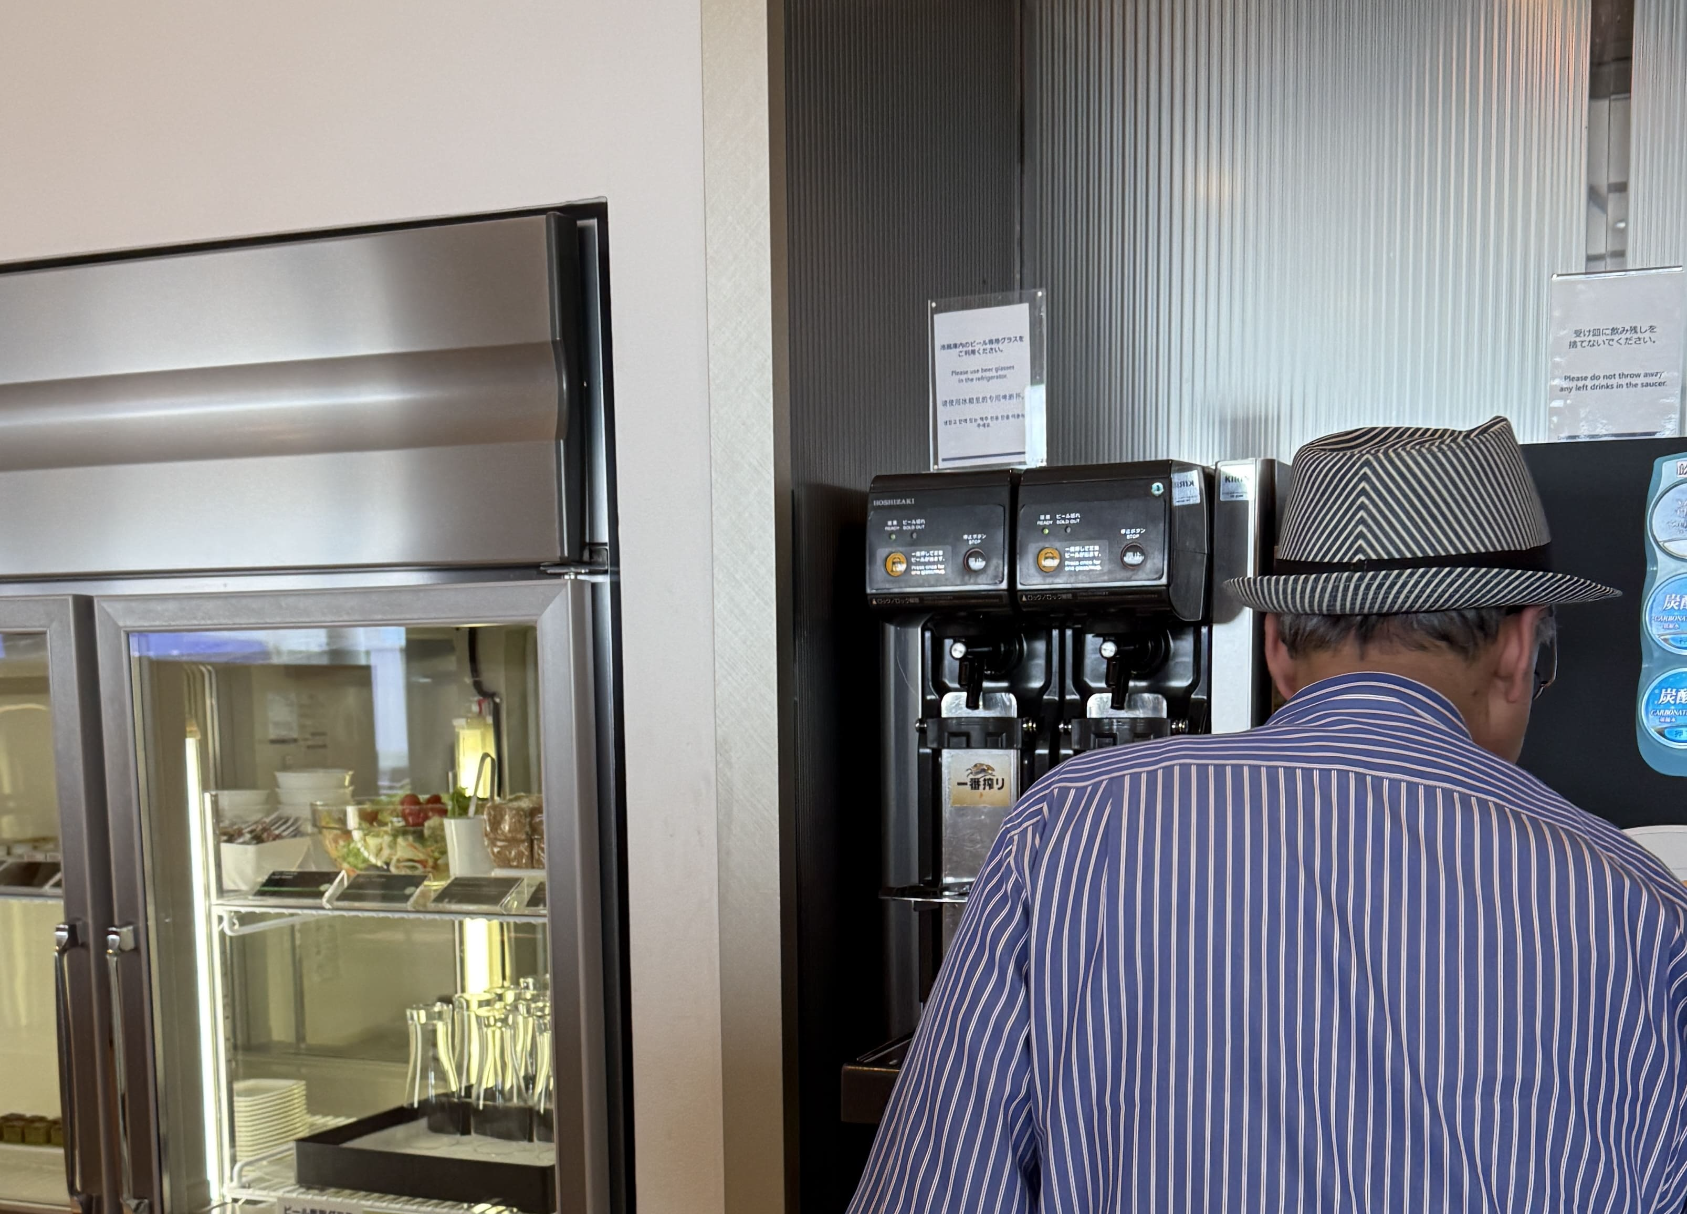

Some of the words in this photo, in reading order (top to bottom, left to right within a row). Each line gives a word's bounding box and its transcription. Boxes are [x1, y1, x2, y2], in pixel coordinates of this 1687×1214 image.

[1574, 325, 1657, 338] 受け皿に飲み残しを
[1568, 336, 1656, 349] 捨てないでください。
[995, 365, 1014, 373] glasses
[1564, 374, 1588, 382] Please
[1590, 373, 1600, 381] do
[1618, 372, 1641, 380] throw
[1643, 371, 1664, 379] away
[1559, 386, 1573, 394] any
[1590, 382, 1614, 390] drinks
[873, 498, 915, 506] HOSHIZAKI
[956, 777, 1005, 791] 一番搾り
